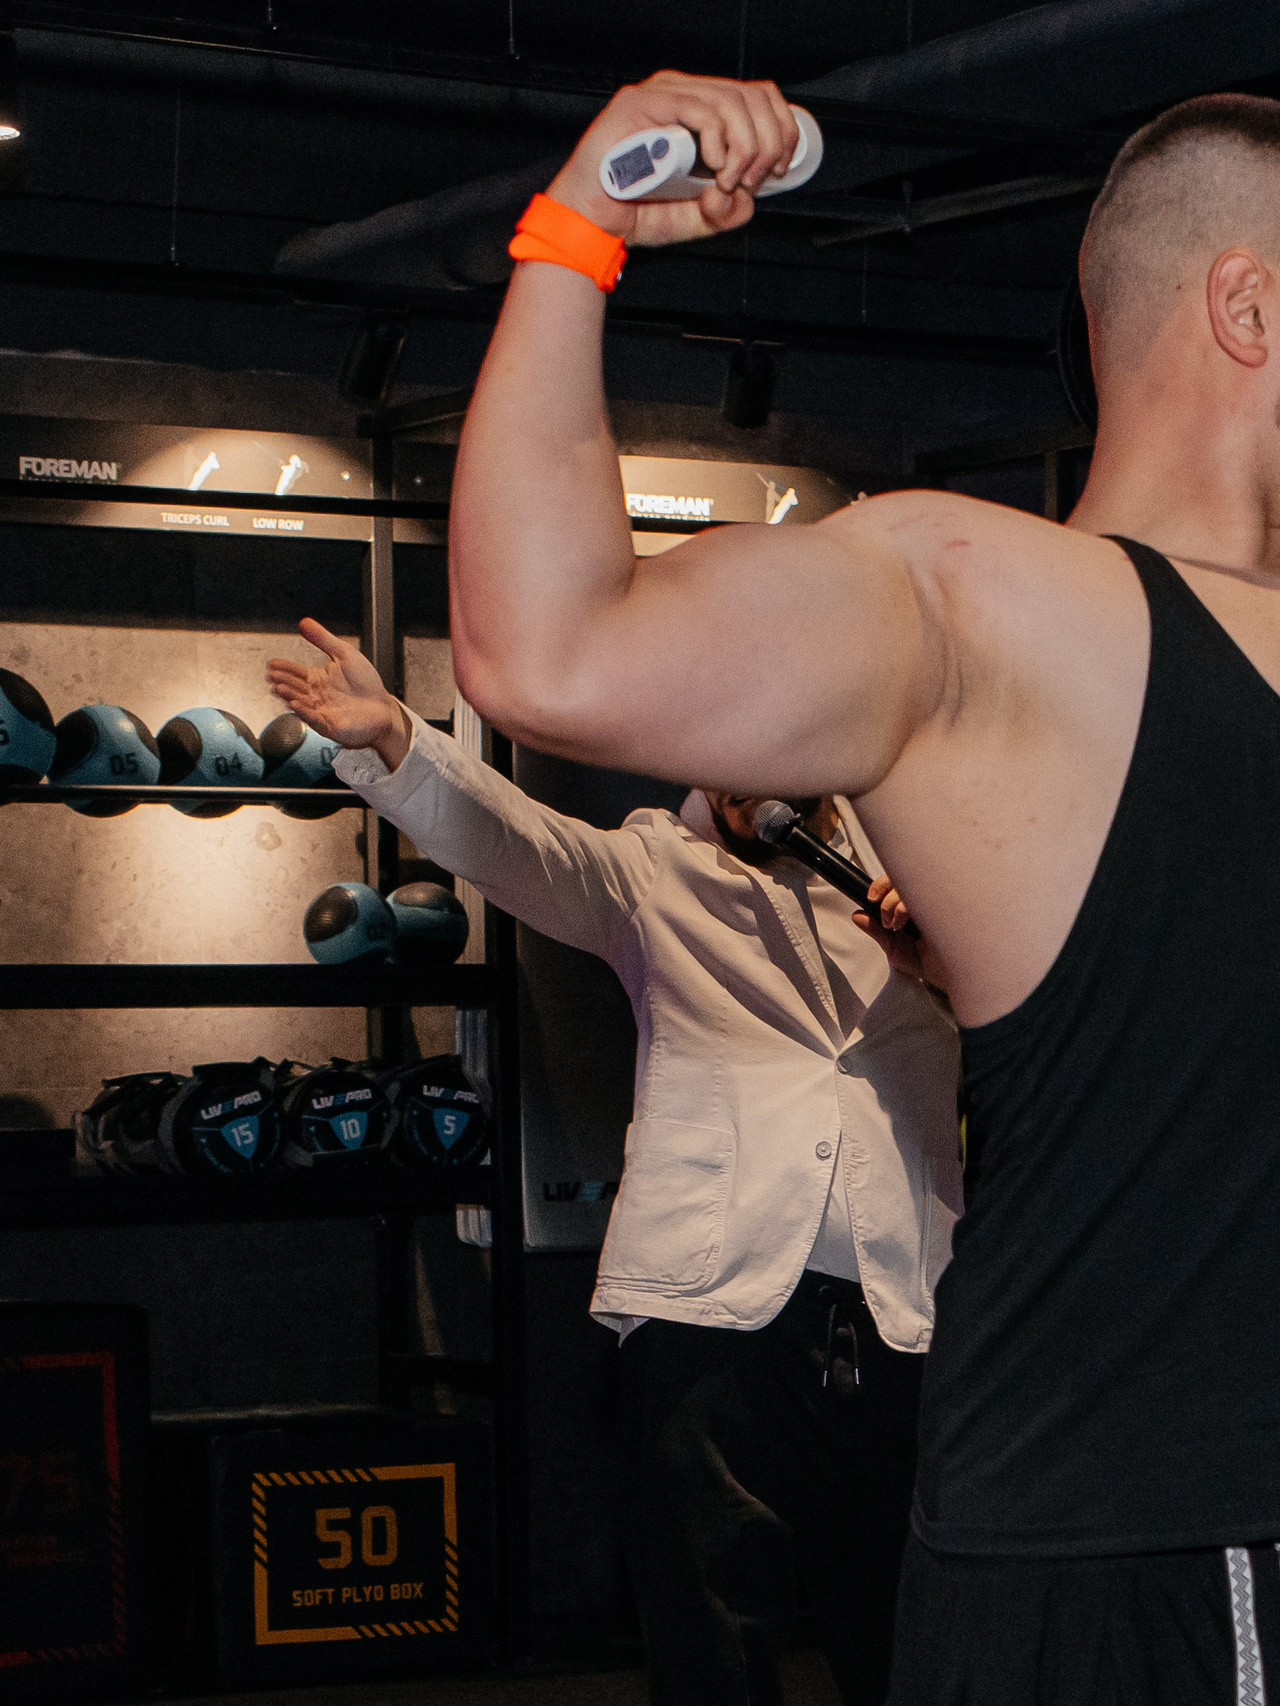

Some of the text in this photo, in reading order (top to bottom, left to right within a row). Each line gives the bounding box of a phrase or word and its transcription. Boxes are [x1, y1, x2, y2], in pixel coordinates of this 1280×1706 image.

[19, 456, 118, 481] FOREMAN
[625, 493, 711, 516] FOREMAN
[160, 512, 230, 527] TRICEPS CURL
[252, 517, 304, 531] LOW ROW
[109, 752, 140, 776] 05
[215, 752, 242, 777] 04
[231, 1122, 255, 1148] 15
[340, 1118, 361, 1140] 10
[443, 1114, 457, 1136] 5
[314, 1504, 399, 1571] 50
[292, 1581, 424, 1607] SOFT PLYO BOX
